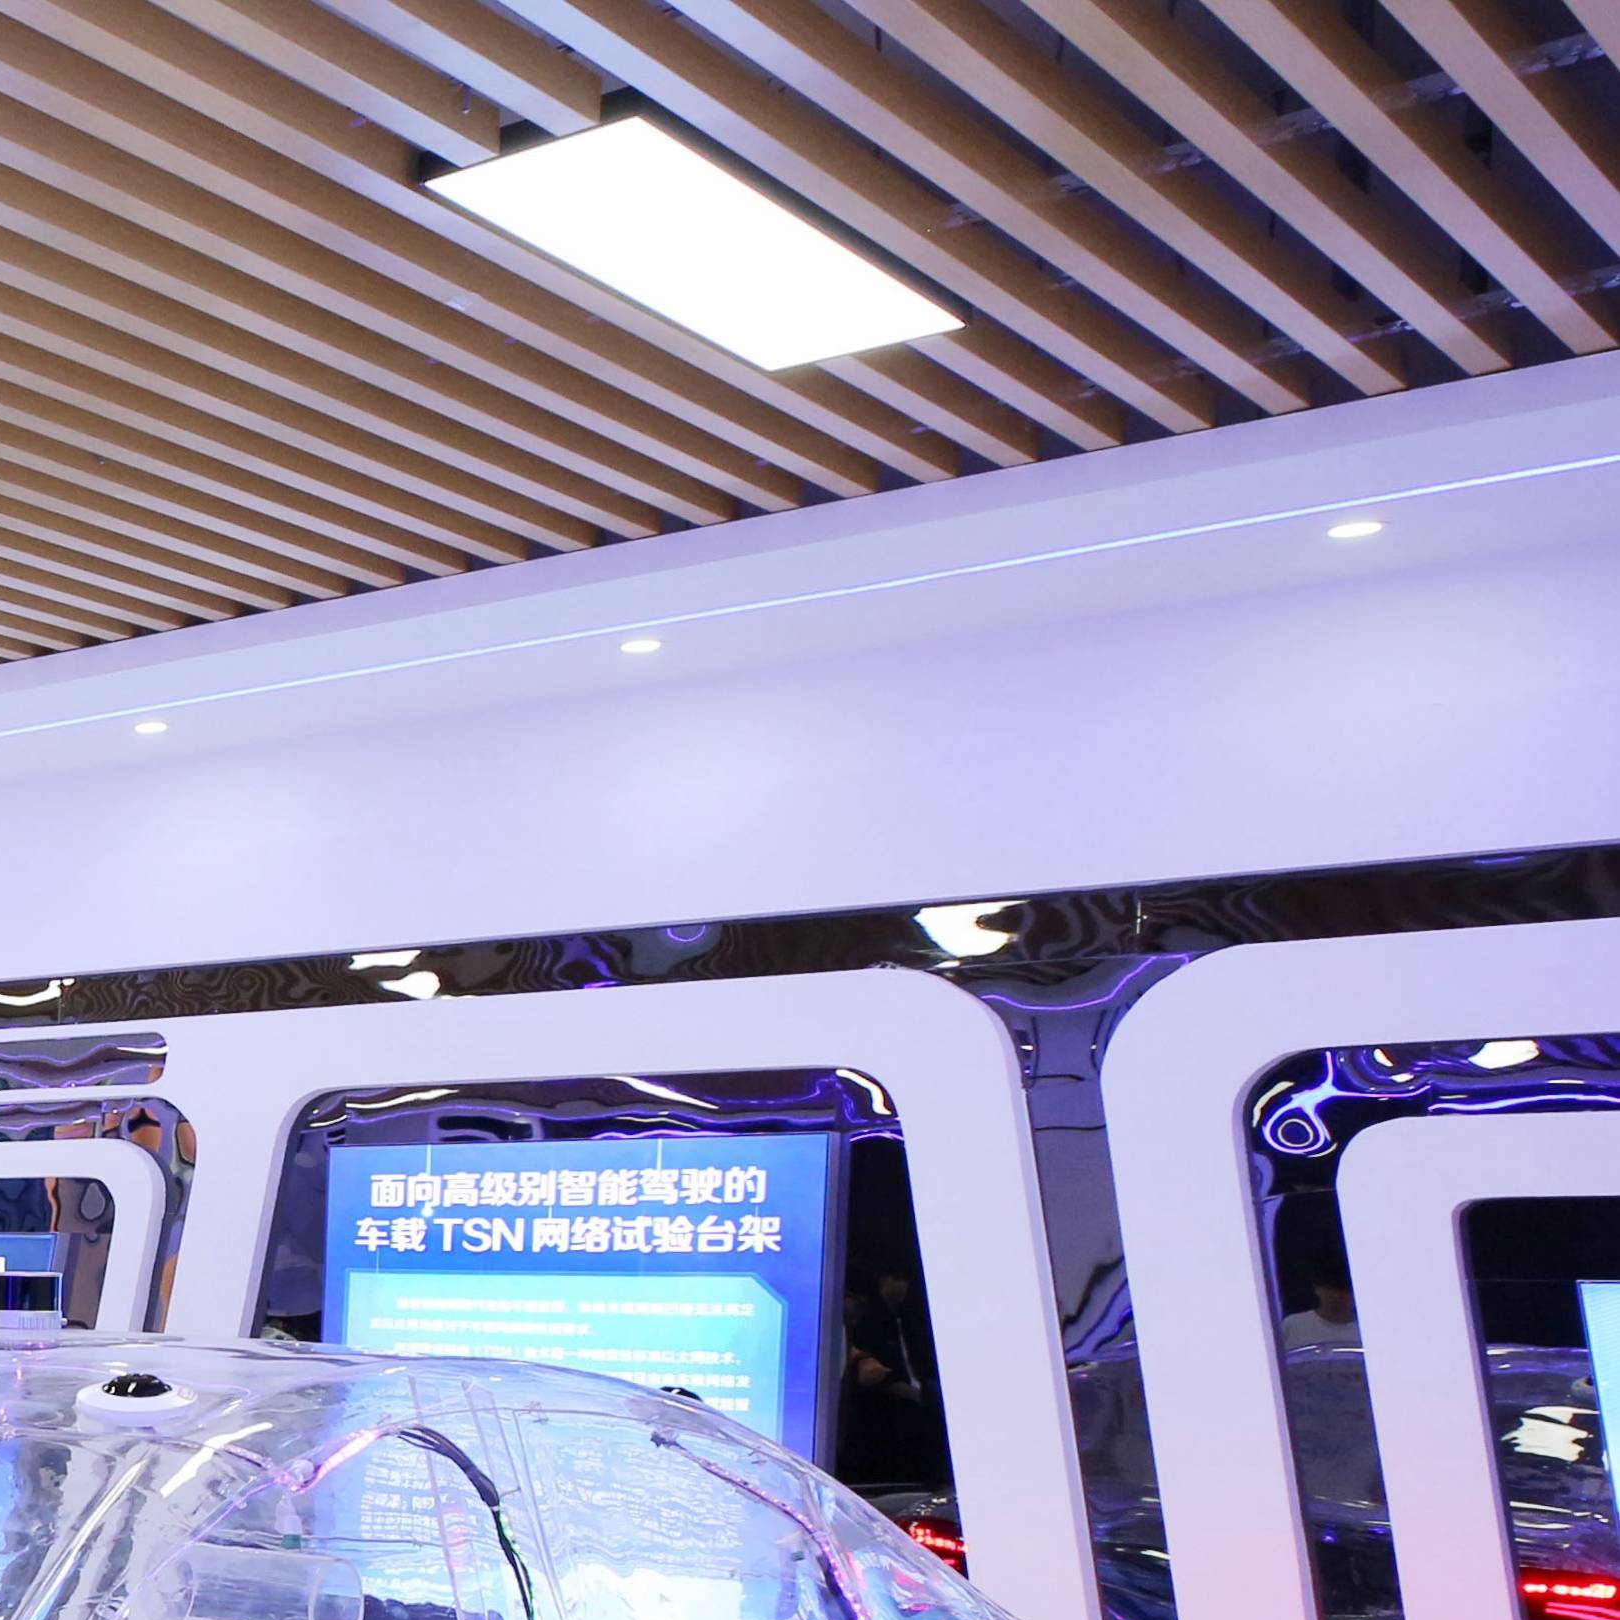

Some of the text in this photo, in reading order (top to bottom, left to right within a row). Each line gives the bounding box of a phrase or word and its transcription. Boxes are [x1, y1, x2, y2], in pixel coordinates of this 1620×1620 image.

[371, 1166, 767, 1208] 面向高级别智能驾驶的
[354, 1214, 781, 1253] 车载 TSN 网络试验台架
